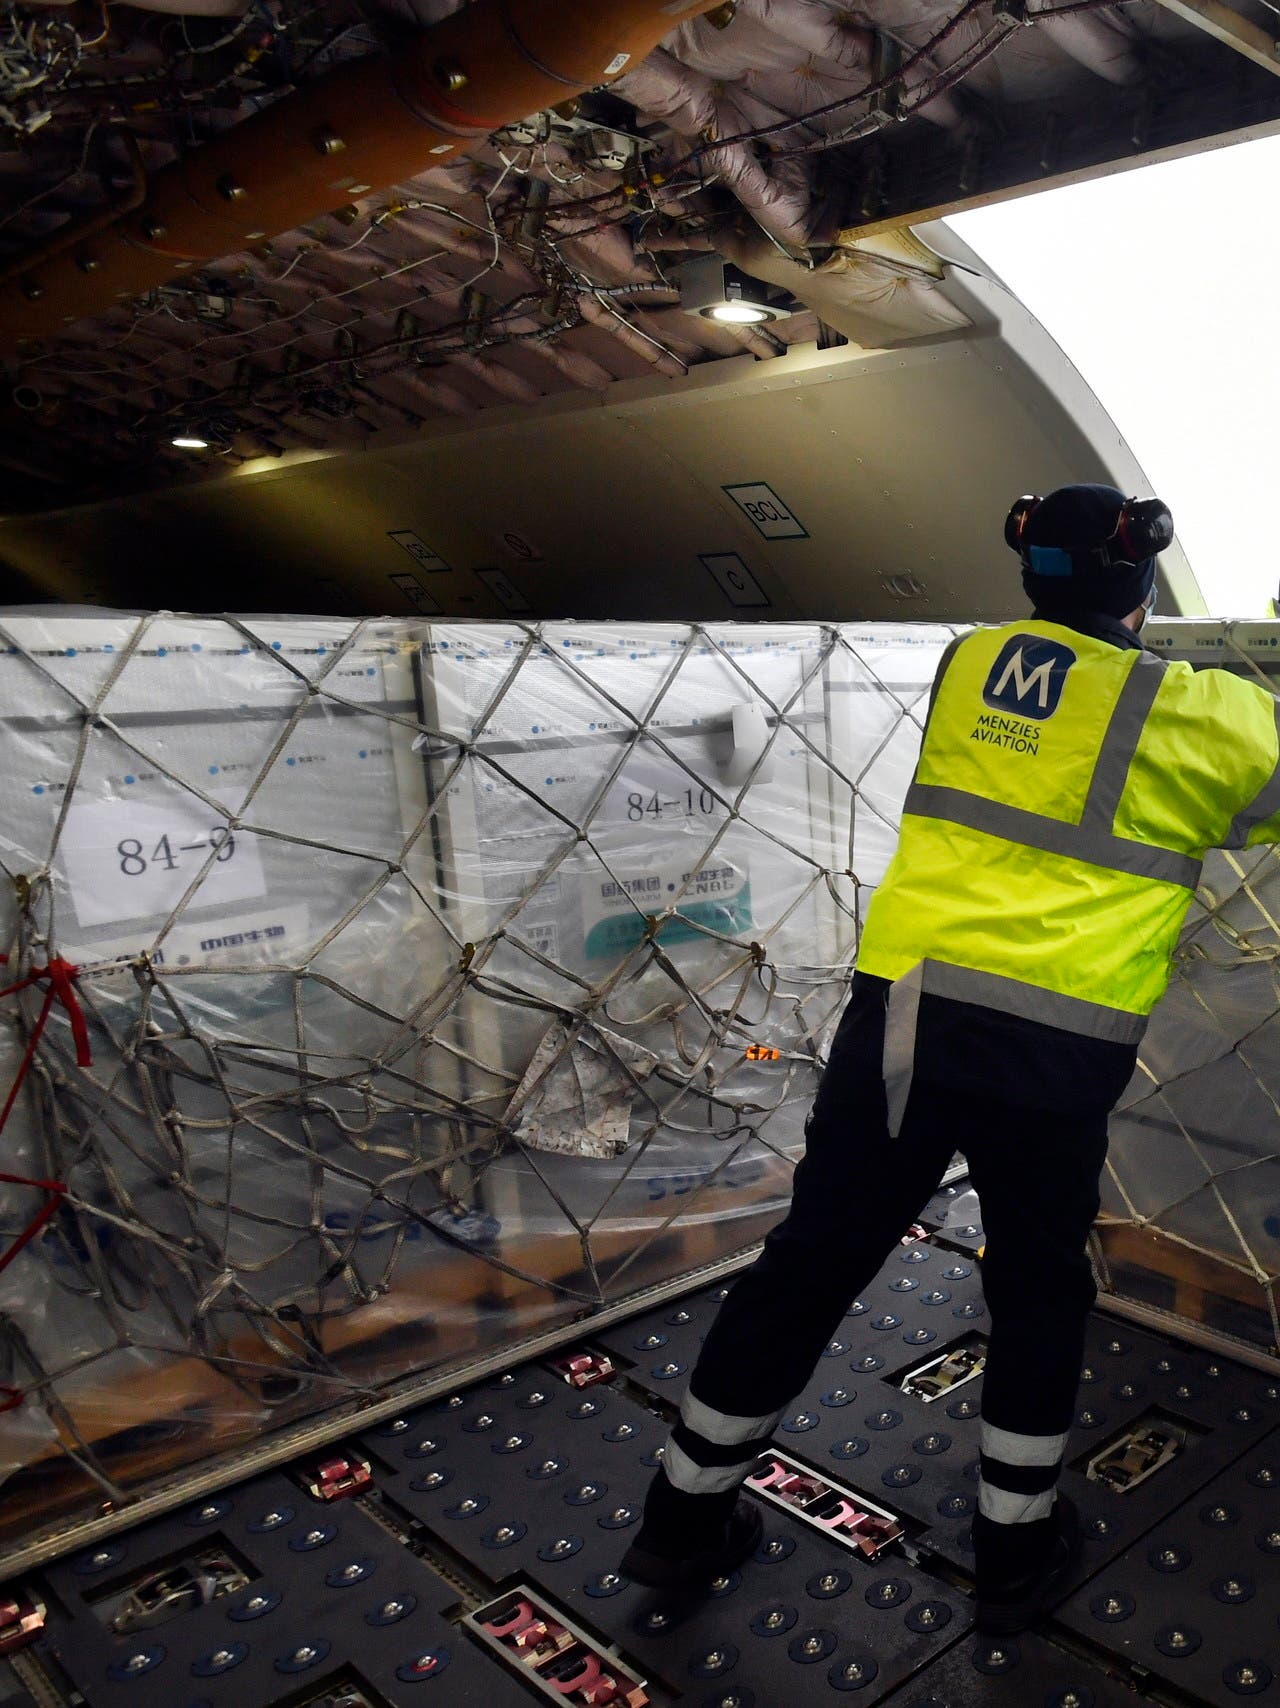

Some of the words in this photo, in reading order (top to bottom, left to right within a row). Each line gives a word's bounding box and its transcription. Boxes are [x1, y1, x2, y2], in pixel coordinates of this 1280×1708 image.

[744, 500, 790, 522] BCL
[726, 570, 745, 591] C
[992, 646, 1057, 707] M
[977, 715, 1041, 740] MENZIES
[970, 728, 1039, 755] AVIATION
[627, 787, 715, 822] 84-10
[117, 826, 236, 876] 84-9
